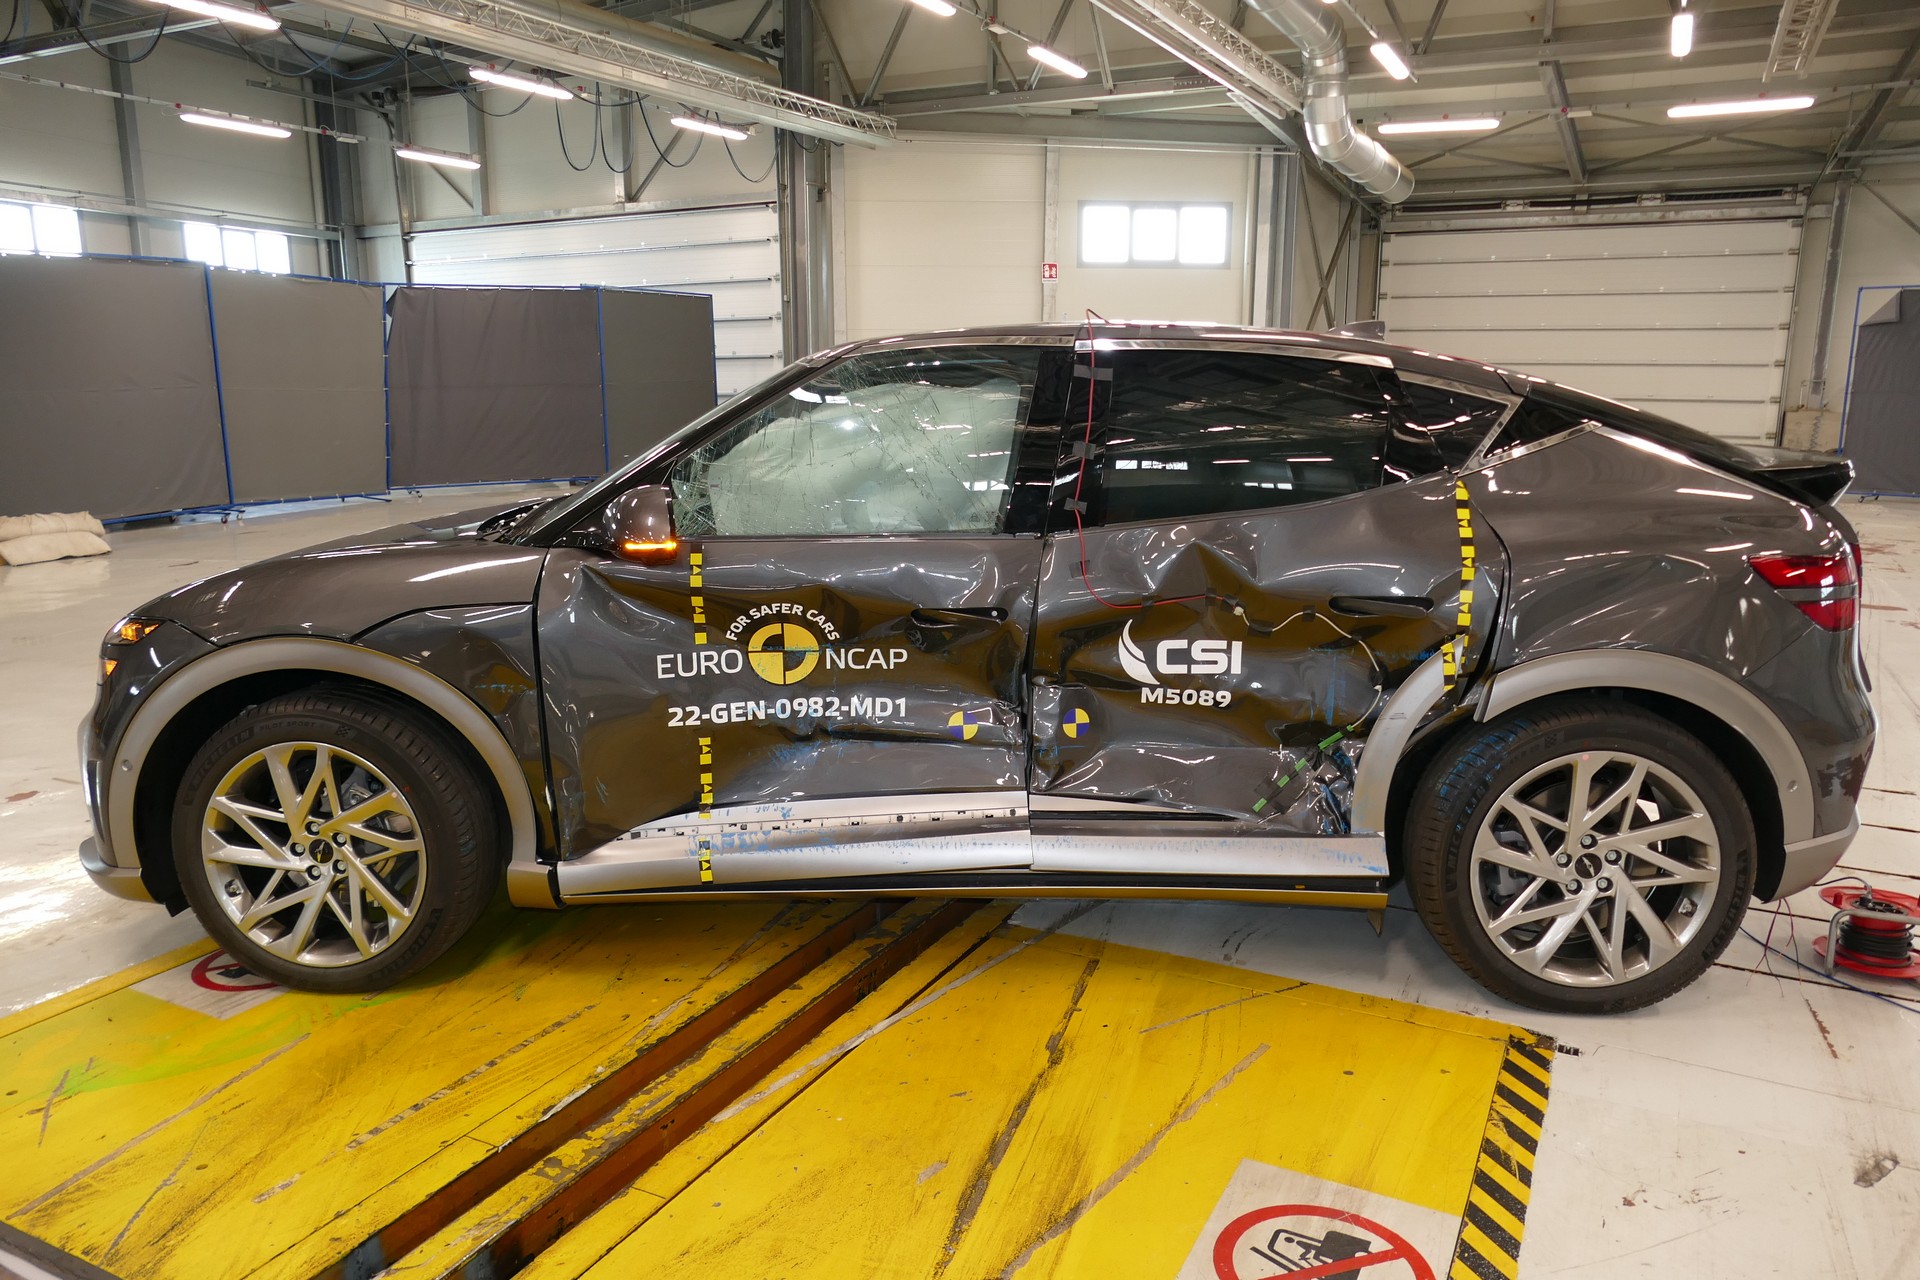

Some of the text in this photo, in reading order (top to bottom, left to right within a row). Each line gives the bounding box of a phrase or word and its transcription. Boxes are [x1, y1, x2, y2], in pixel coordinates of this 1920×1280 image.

[725, 603, 841, 641] FOR SAFER CARS
[656, 648, 909, 679] EURO NCAP
[1156, 639, 1243, 675] CSI
[668, 696, 907, 727] 22-GEN-0982-MD1
[1140, 687, 1232, 708] M5089
